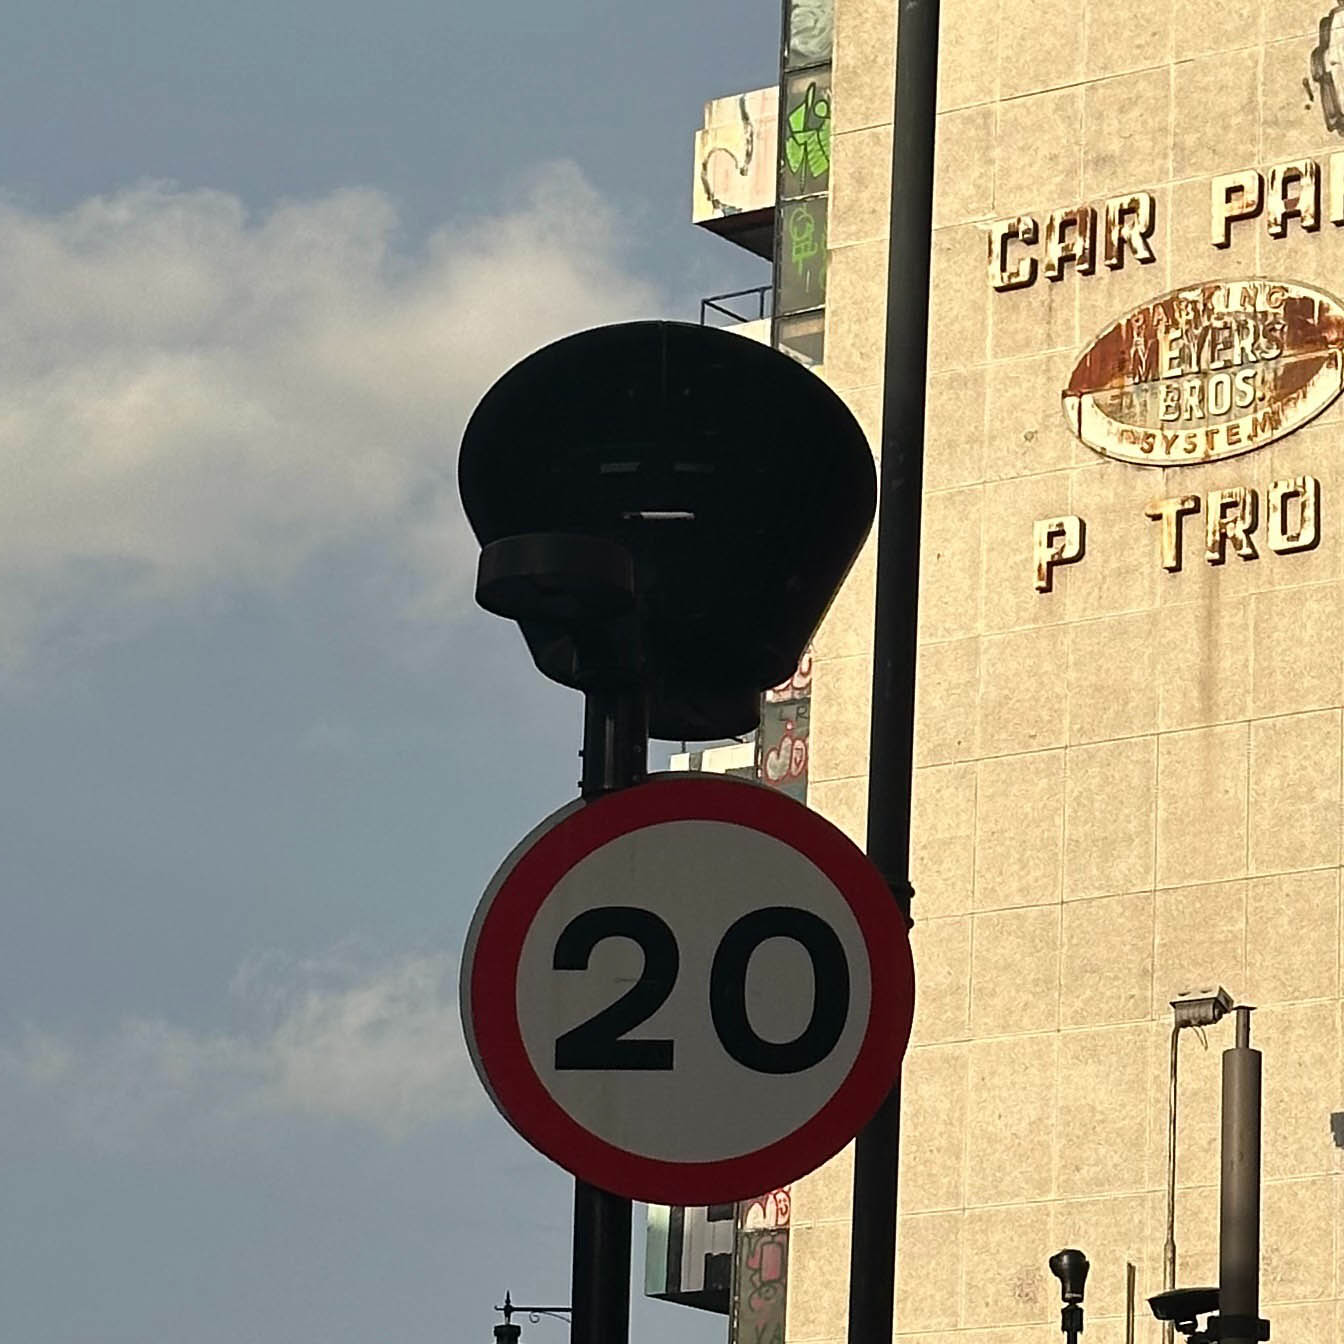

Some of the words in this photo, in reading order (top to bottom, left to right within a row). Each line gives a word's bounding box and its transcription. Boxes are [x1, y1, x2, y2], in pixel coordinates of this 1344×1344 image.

[987, 190, 1157, 292] CAR
[1129, 315, 1287, 385] MEYERS
[552, 905, 851, 1075] 20
